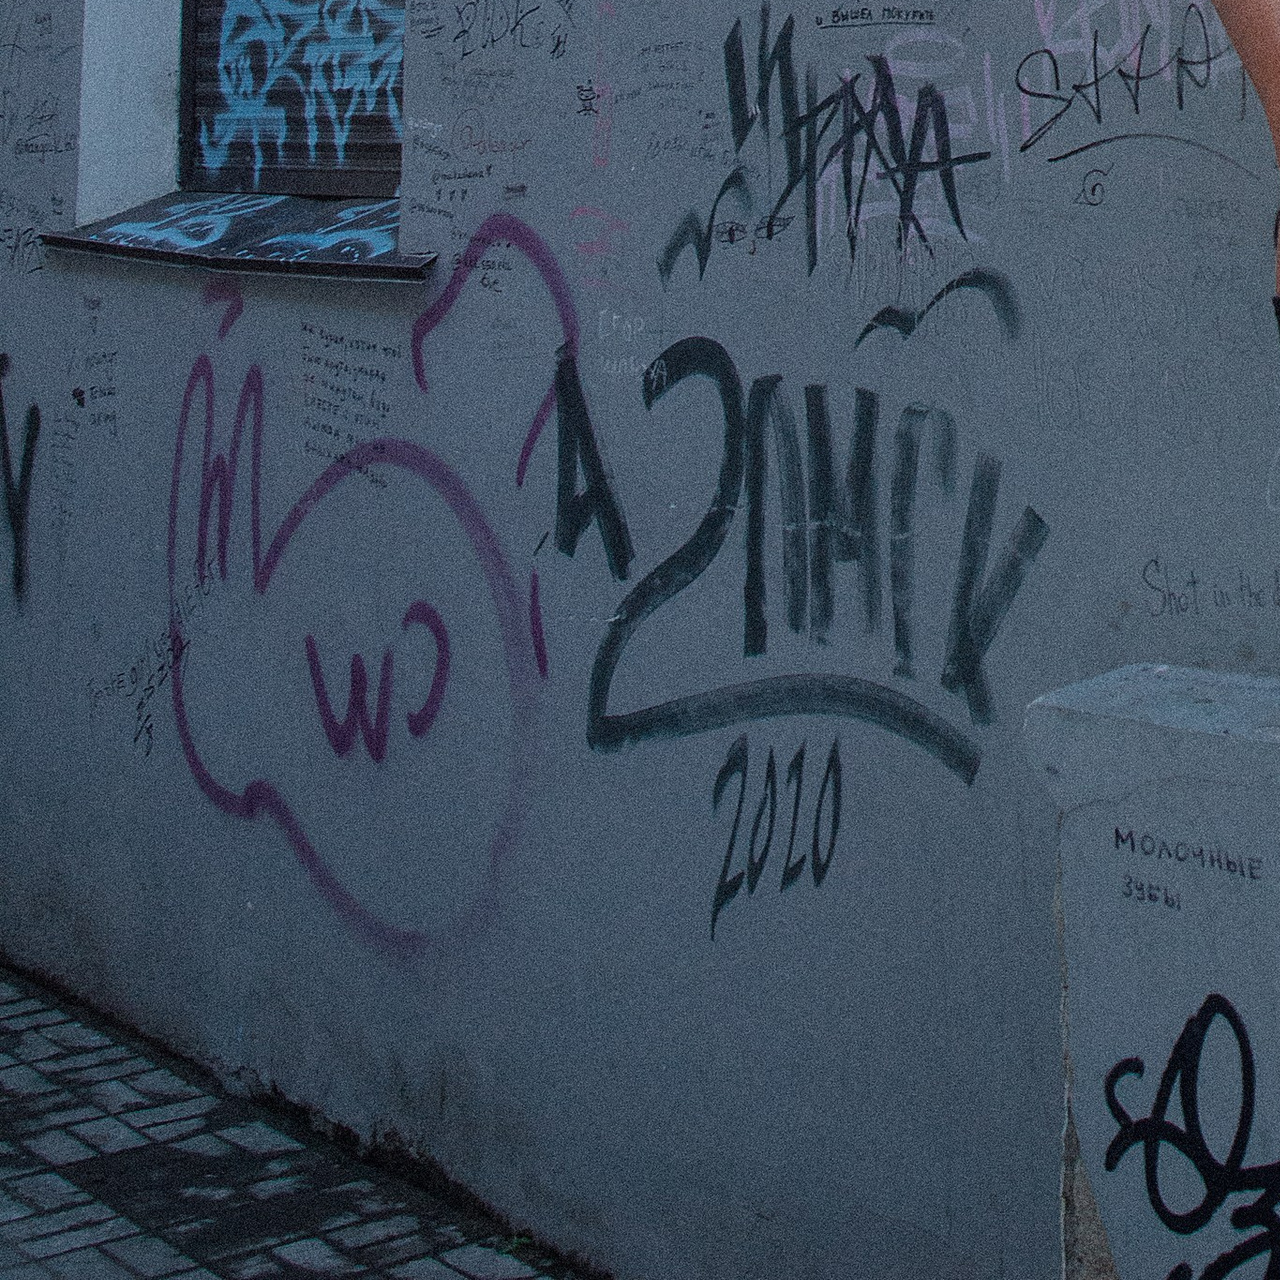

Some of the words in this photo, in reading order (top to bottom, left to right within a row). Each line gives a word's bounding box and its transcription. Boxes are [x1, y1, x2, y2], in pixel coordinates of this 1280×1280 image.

[1141, 556, 1199, 618] Shot
[1115, 827, 1263, 880] МОЛОЧНЫЕ
[1122, 874, 1182, 911] ЗУБЫ
